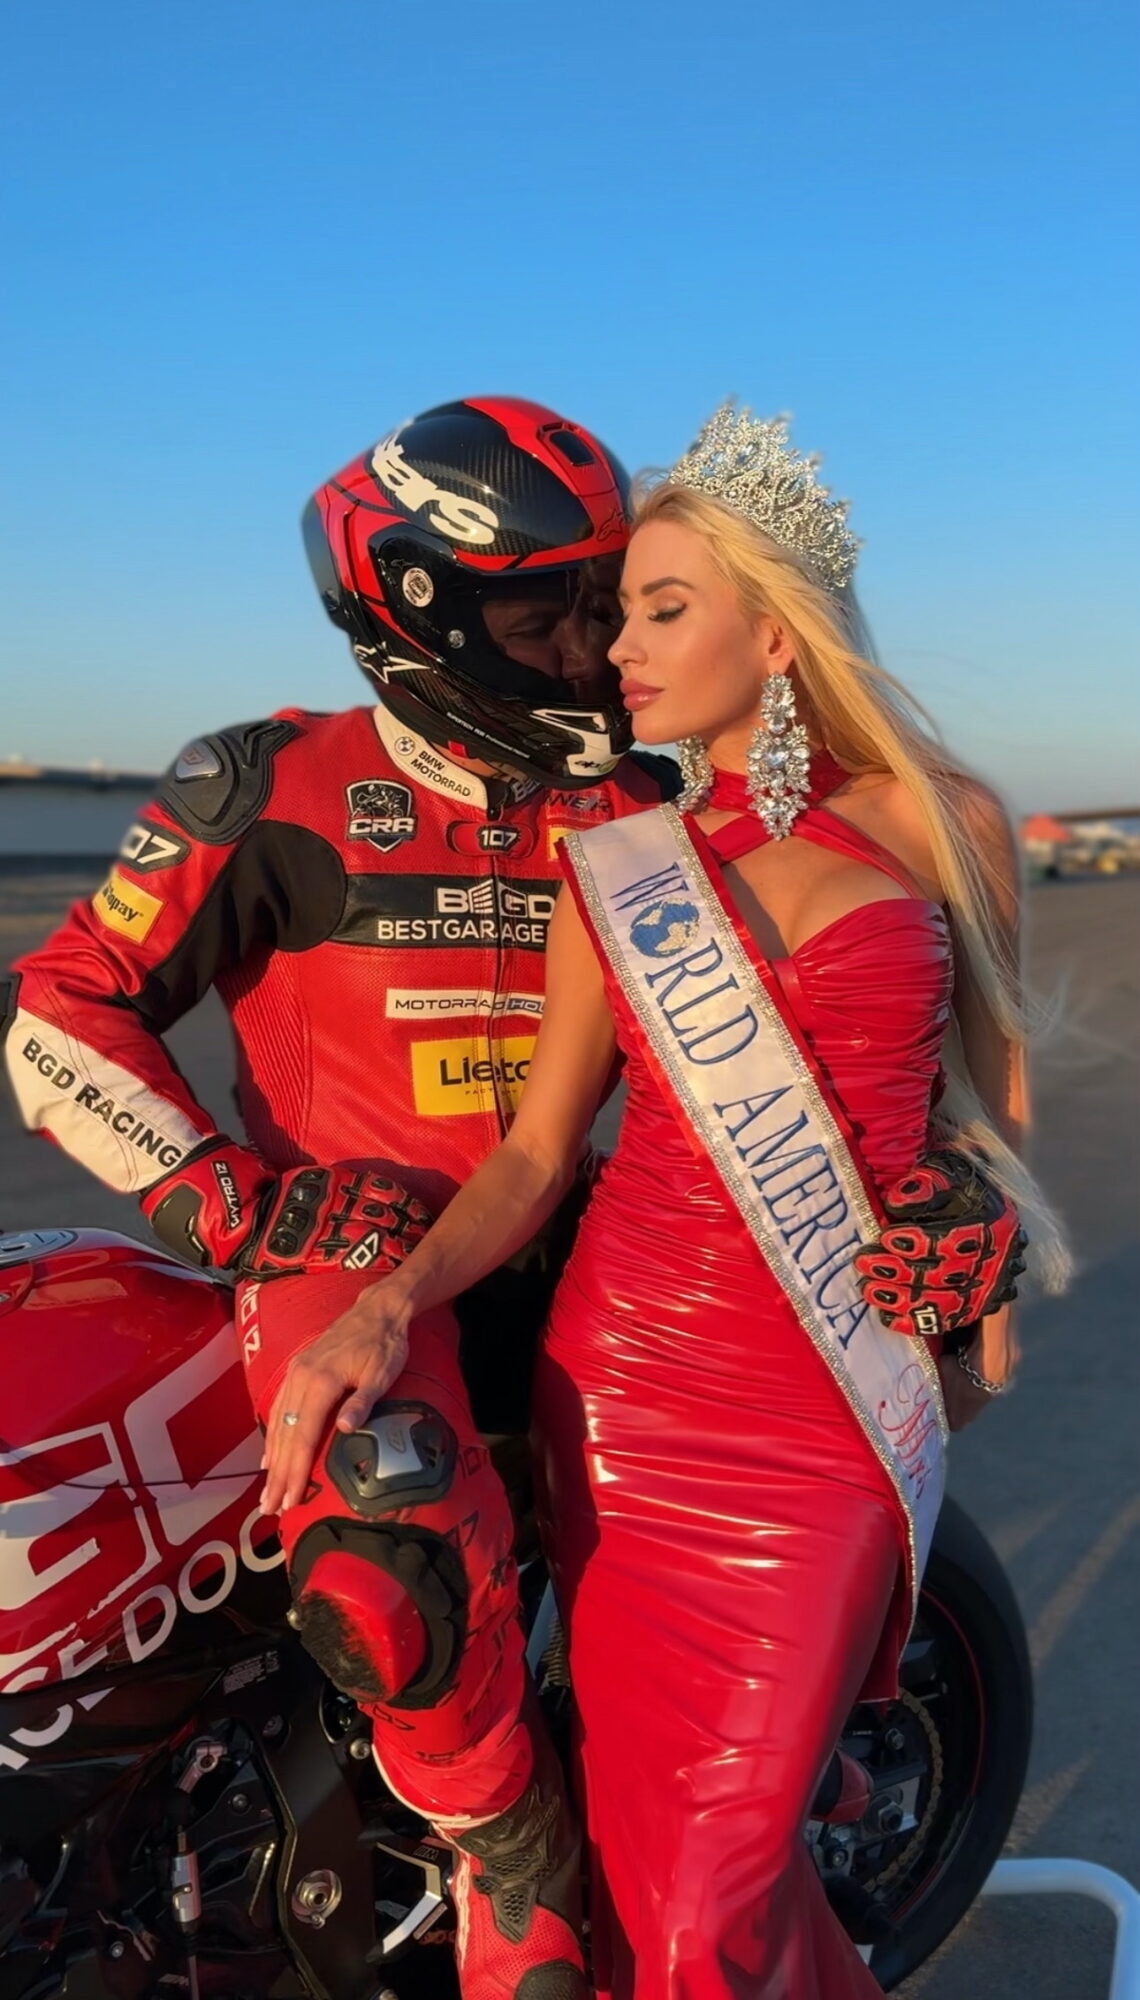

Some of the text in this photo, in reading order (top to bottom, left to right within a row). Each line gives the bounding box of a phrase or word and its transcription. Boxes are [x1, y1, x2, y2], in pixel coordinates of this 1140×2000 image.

[418, 750, 446, 771] BMW
[410, 758, 471, 797] MOTORRAD
[349, 817, 415, 834] CRA
[481, 829, 518, 847] 107
[395, 999, 505, 1011] MOTORRAD
[22, 1037, 182, 1168] BGD RACING
[712, 1084, 870, 1351] AMERICA
[344, 1231, 380, 1270] 107
[914, 1306, 939, 1335] 107
